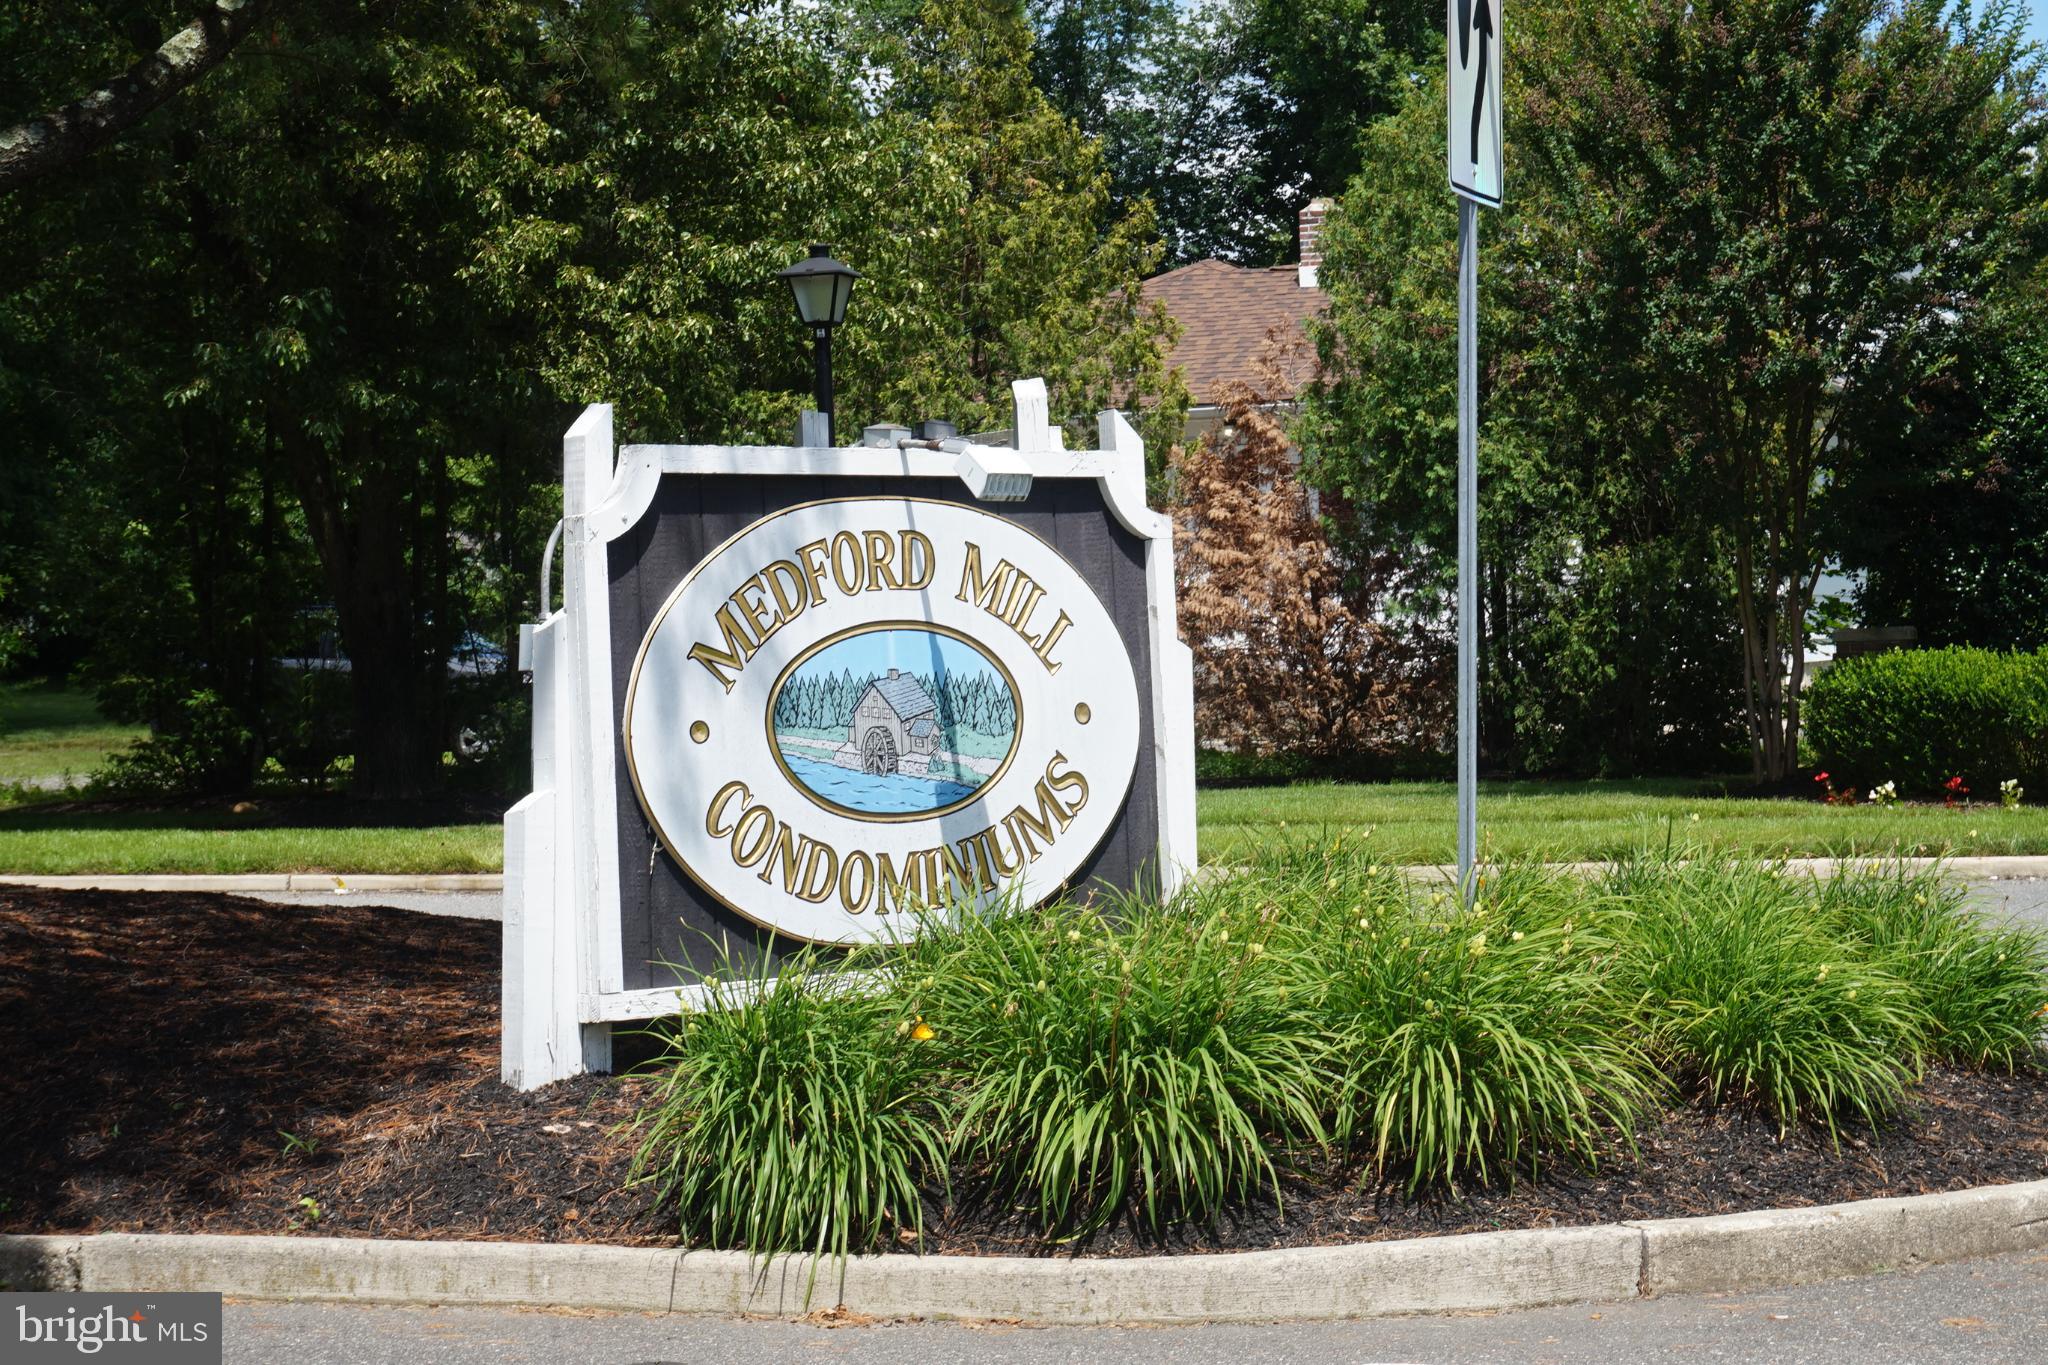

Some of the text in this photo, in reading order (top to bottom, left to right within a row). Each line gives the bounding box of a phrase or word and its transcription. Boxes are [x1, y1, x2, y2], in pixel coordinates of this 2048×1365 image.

[687, 530, 1074, 694] MEDFORD MILL
[706, 750, 1090, 915] CONDOMINIUMS
